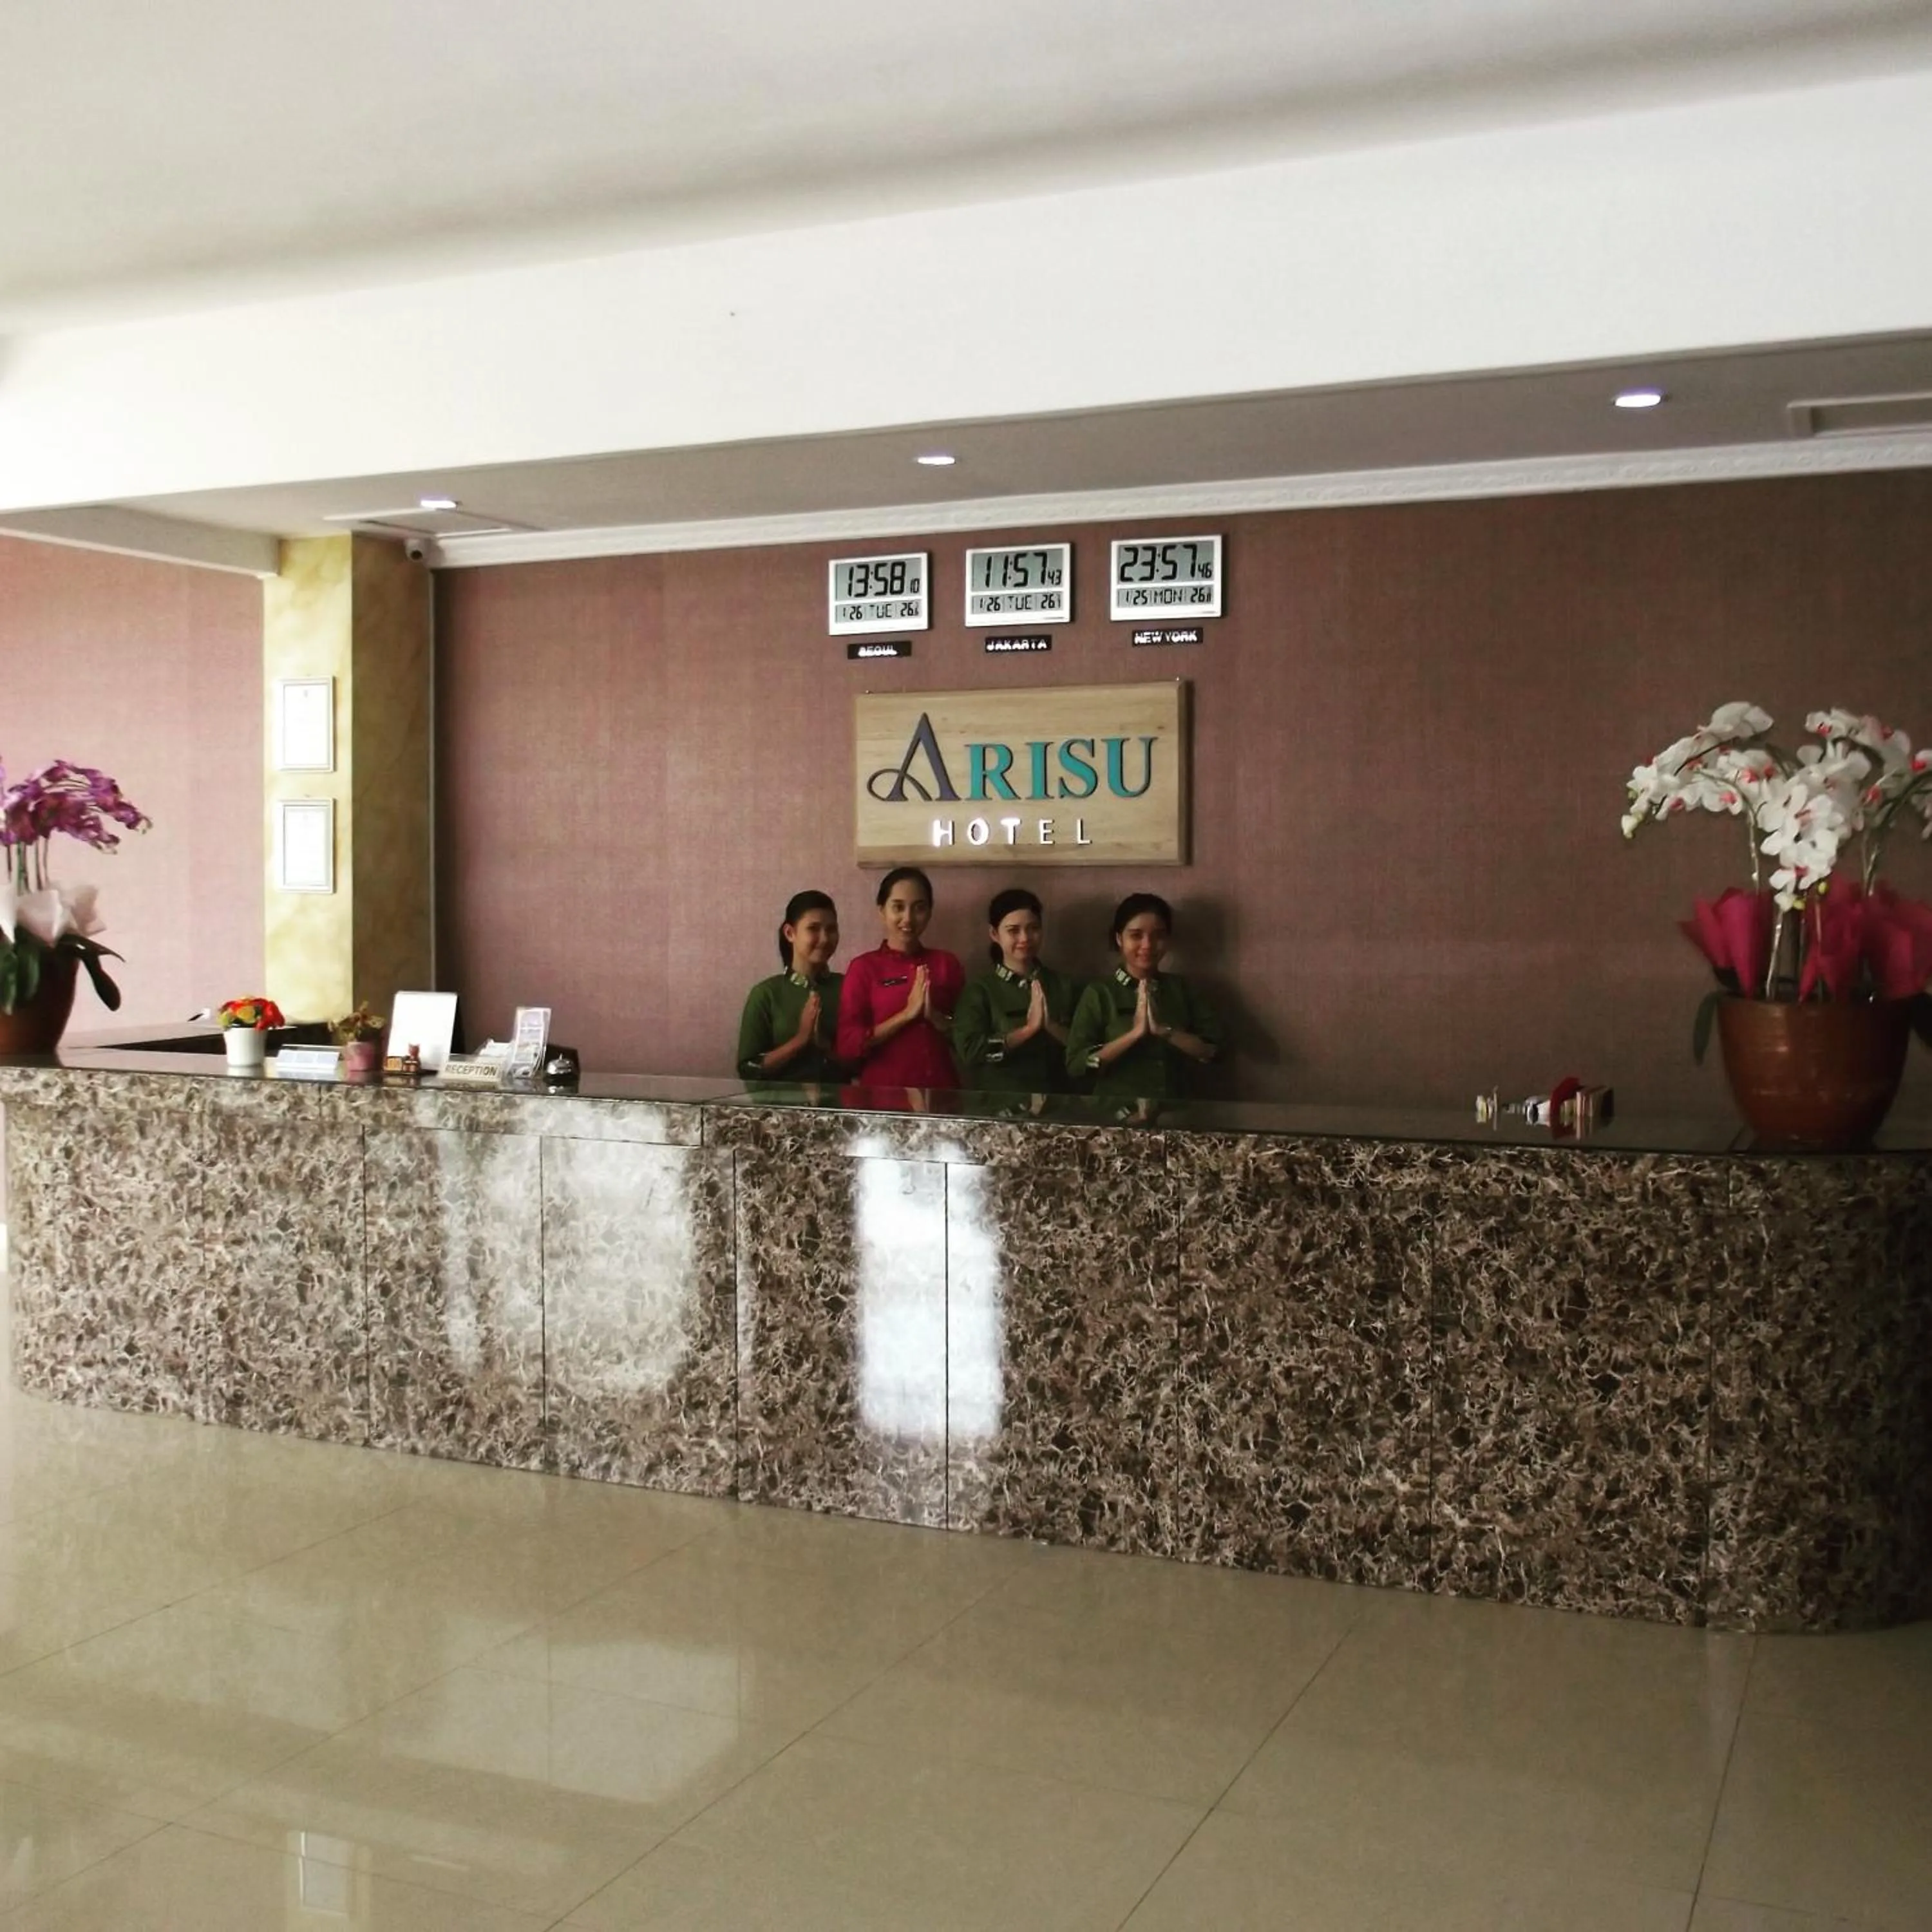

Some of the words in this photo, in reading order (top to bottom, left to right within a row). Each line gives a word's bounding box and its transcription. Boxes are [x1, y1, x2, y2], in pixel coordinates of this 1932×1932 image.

[985, 552, 1047, 588] 11:57
[1048, 569, 1062, 585] 43
[1120, 544, 1197, 582] 23:57
[1197, 562, 1212, 578] 46
[848, 562, 905, 598] 13:58
[1008, 595, 1032, 610] TUE
[1153, 589, 1182, 604] MON
[987, 639, 1047, 650] JAKARTA
[1134, 631, 1162, 644] NEW
[1165, 630, 1197, 643] YORK
[858, 645, 897, 657] SEOUL
[867, 712, 1158, 802] ARISU
[933, 818, 1093, 847] HOTEL
[445, 1064, 498, 1076] RECEPTION
